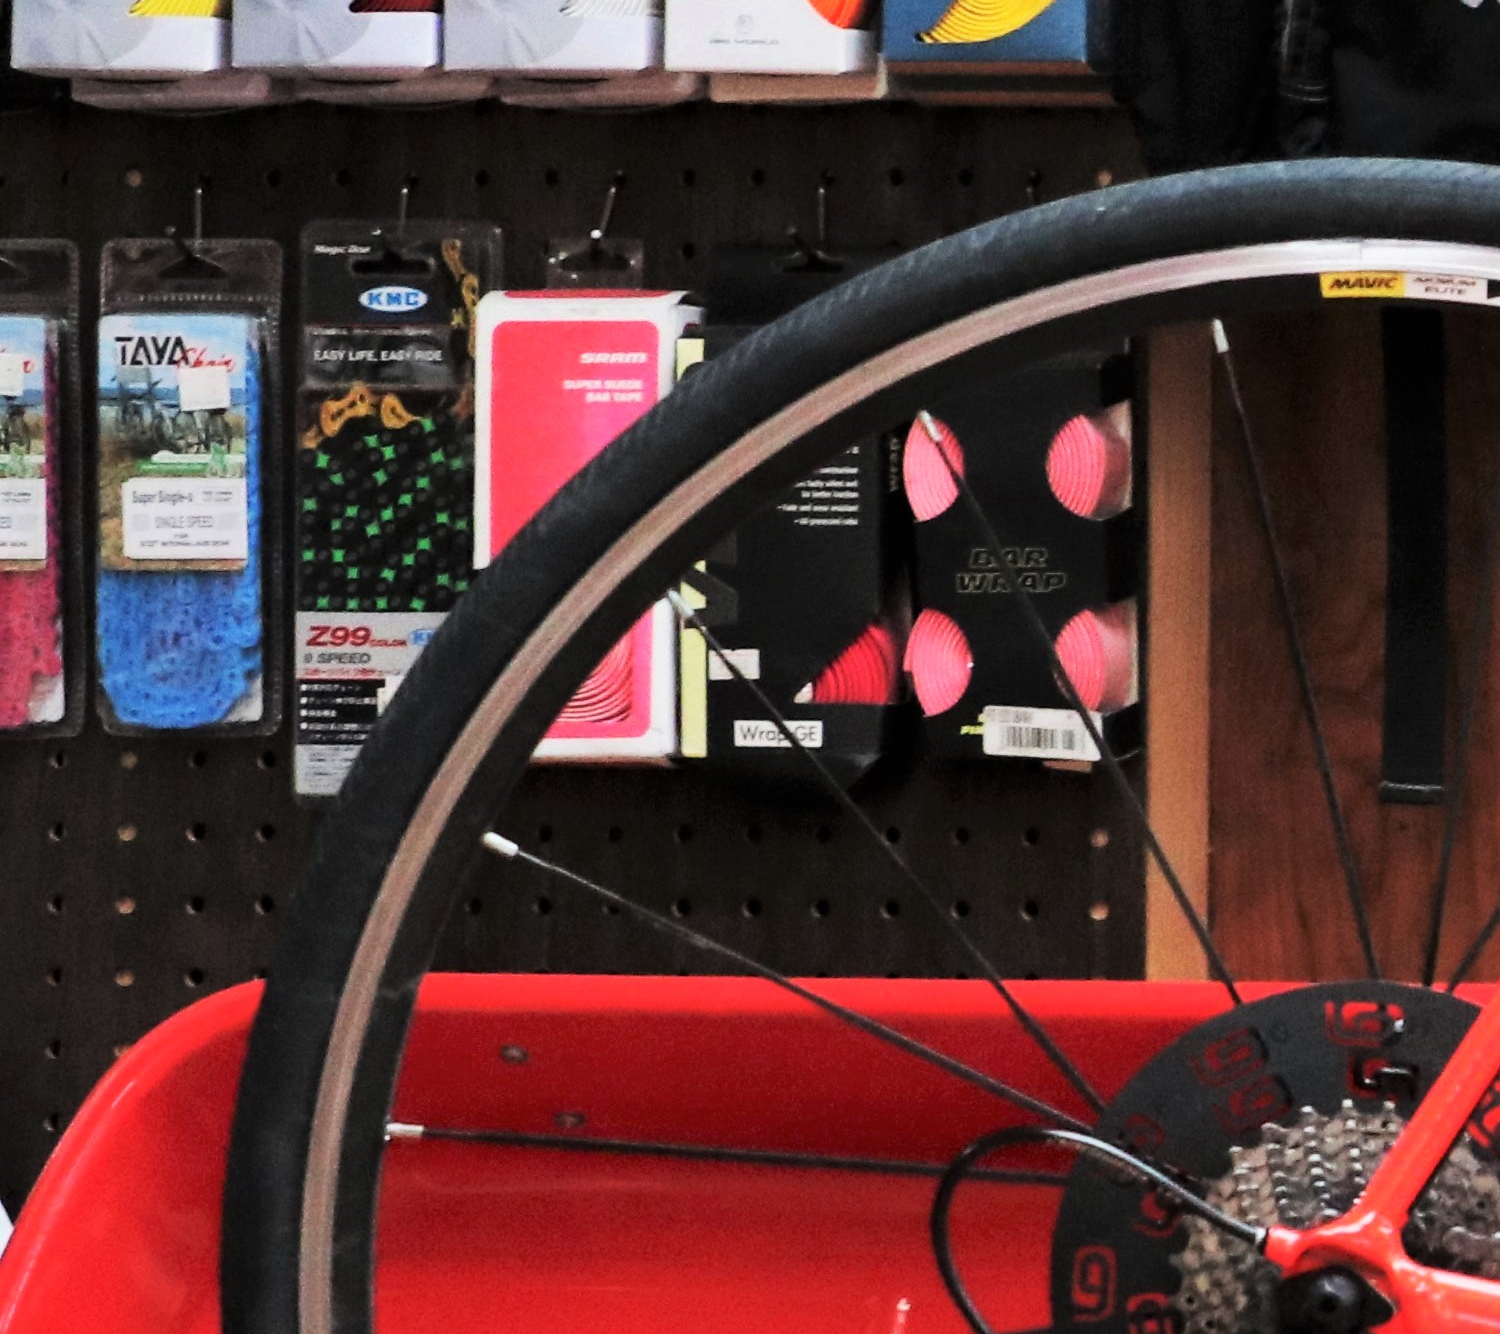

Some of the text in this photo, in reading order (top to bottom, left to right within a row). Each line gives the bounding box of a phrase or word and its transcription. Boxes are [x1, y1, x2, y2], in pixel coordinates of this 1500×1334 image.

[1329, 276, 1398, 291] MAVIC
[368, 292, 419, 306] KMC
[115, 336, 190, 365] TAYA
[313, 350, 344, 361] EASY
[381, 350, 412, 361] EASY
[415, 350, 443, 361] RIDE
[580, 352, 647, 364] SRAM
[563, 379, 602, 389] SUPER
[586, 392, 642, 402] BAR TAPE
[307, 625, 371, 646] Z99
[317, 653, 371, 663] SPEED
